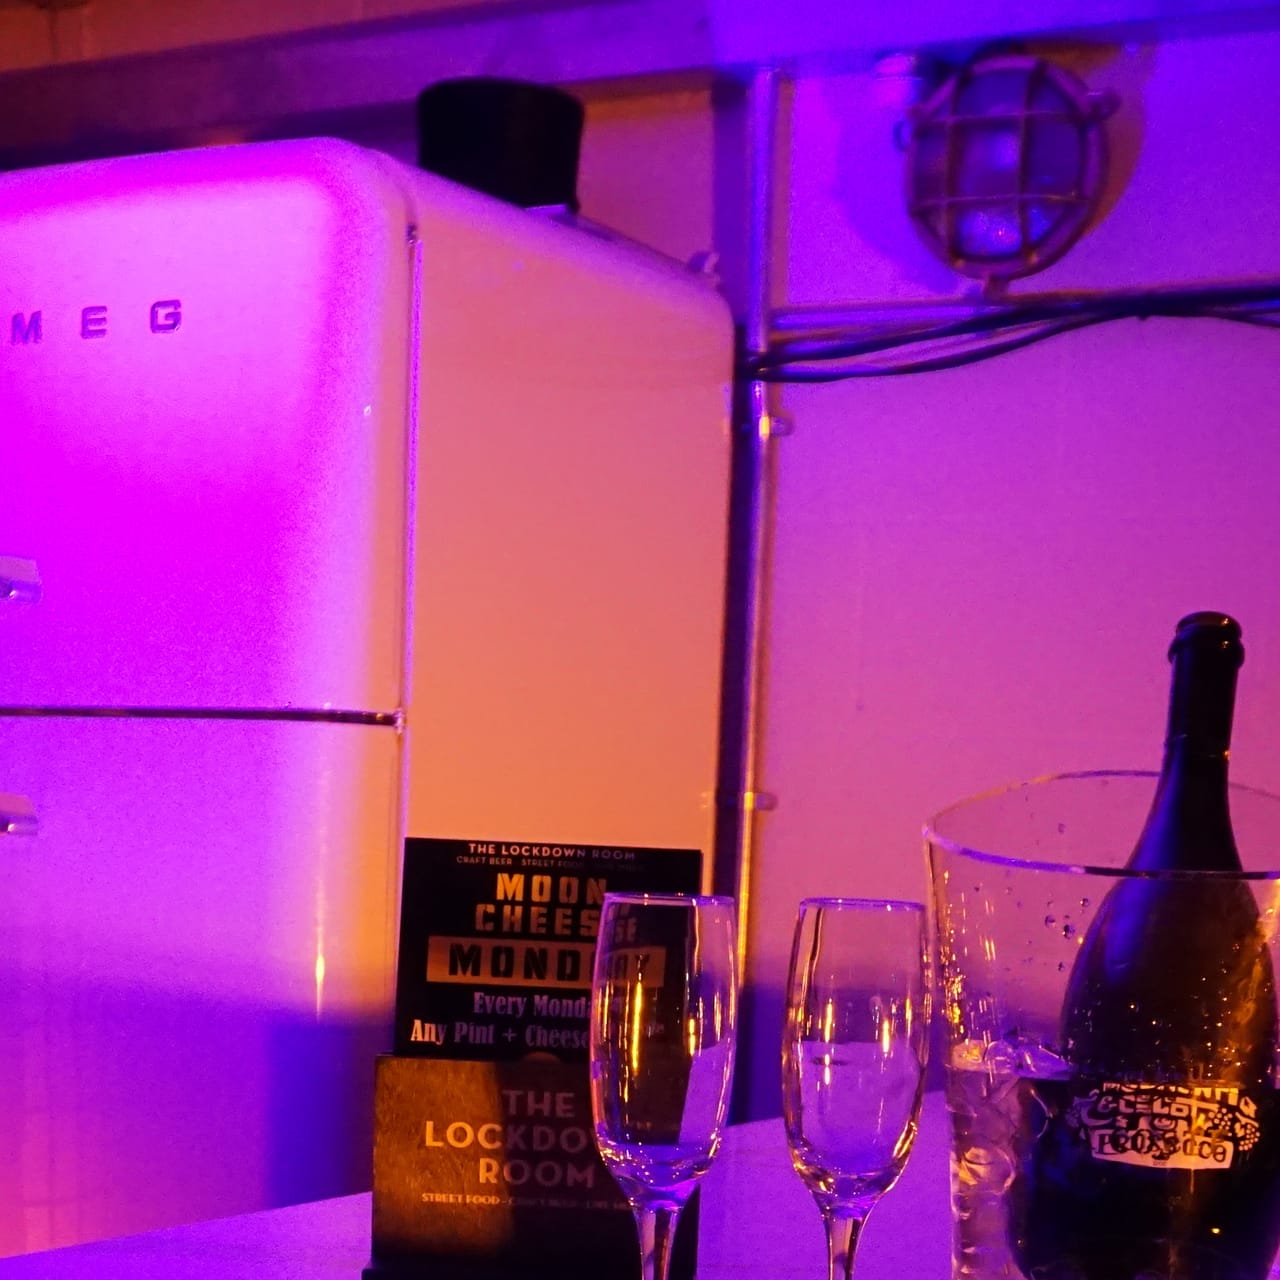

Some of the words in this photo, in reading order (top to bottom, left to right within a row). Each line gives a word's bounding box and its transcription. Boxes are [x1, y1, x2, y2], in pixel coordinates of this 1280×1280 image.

[456, 855, 486, 865] CRAFT
[489, 857, 513, 866] BEER
[520, 858, 554, 867] STREET
[468, 843, 496, 855] THE
[501, 844, 586, 858] LOCKDOWN
[592, 850, 635, 861] ROOM
[496, 872, 607, 904] MOON
[475, 903, 637, 941] CHEES
[472, 991, 528, 1017] Every
[532, 994, 592, 1018] Mond
[410, 1018, 446, 1046] Any
[453, 1022, 496, 1045] Pint
[502, 1089, 576, 1118] THE
[425, 1120, 597, 1153] LOCKDO
[478, 1157, 595, 1188] ROOM
[422, 1193, 462, 1203] STREET
[465, 1194, 500, 1205] FOOD
